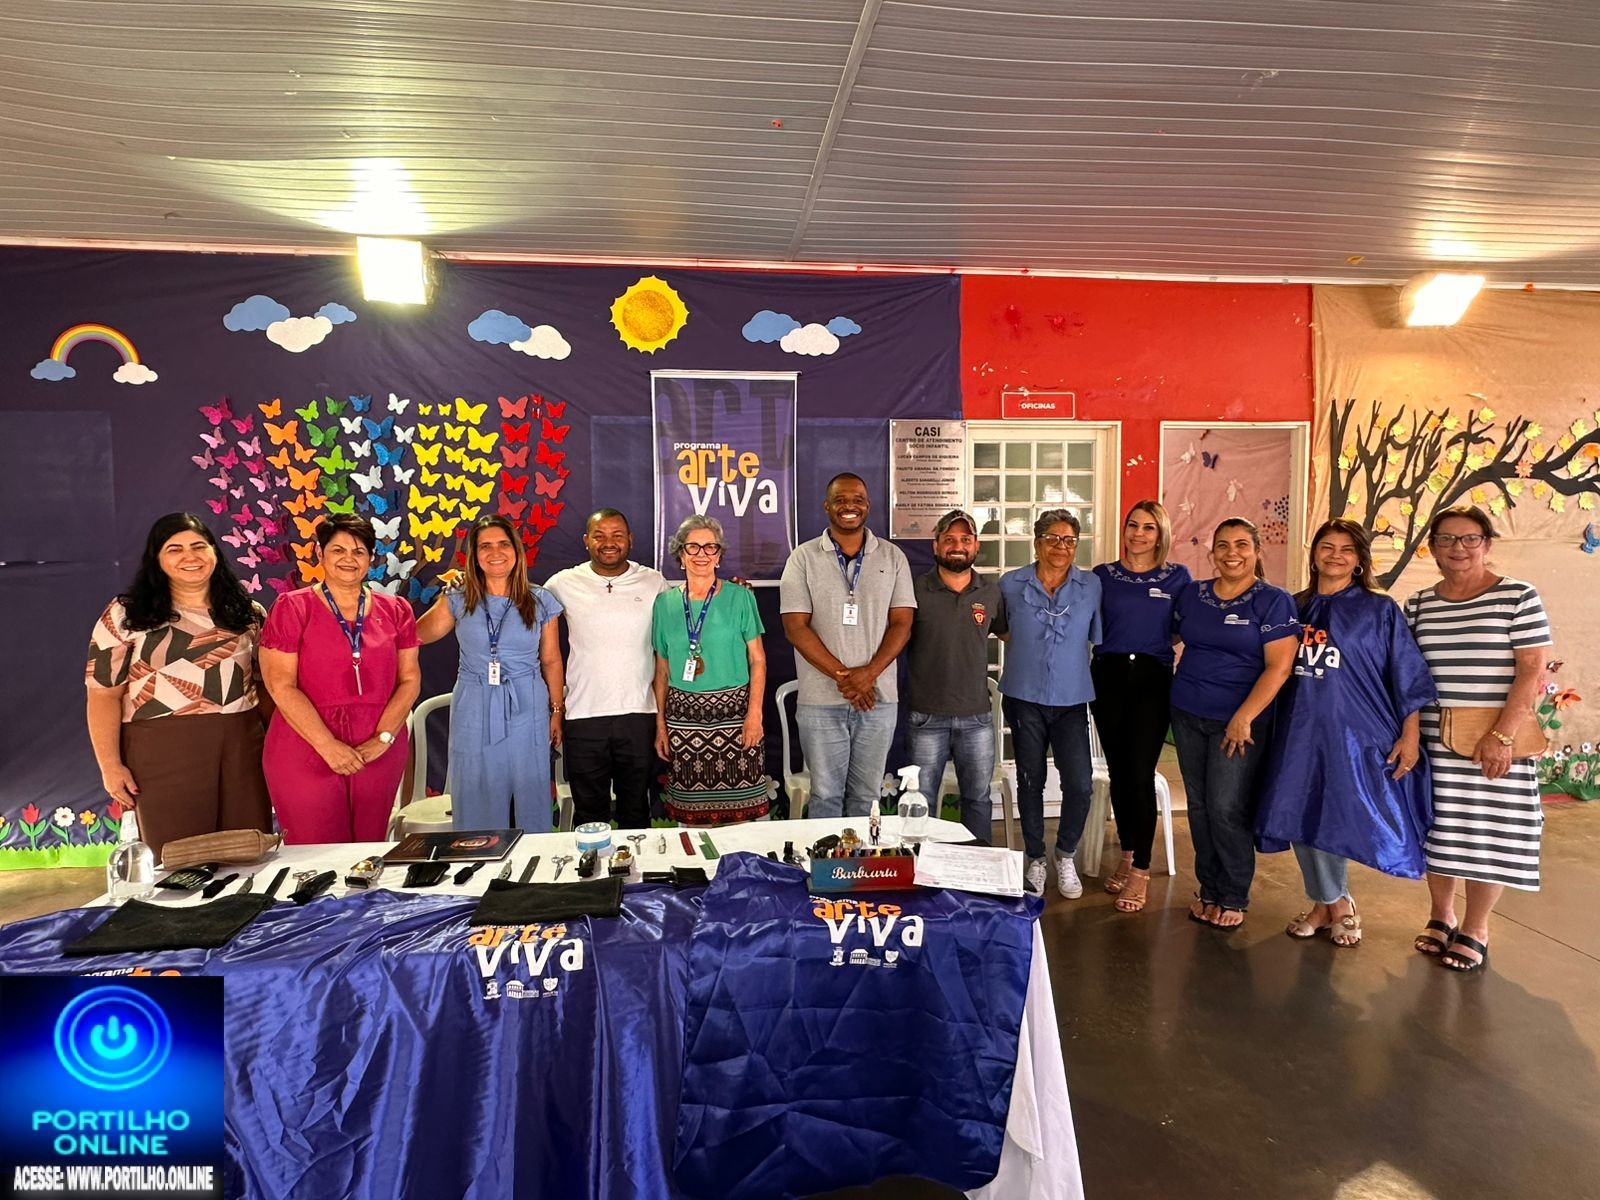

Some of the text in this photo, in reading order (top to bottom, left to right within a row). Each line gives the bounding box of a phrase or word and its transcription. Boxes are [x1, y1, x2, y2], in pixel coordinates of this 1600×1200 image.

[1020, 402, 1056, 410] OFICINAS
[914, 427, 941, 437] CASI
[673, 442, 721, 450] programa
[676, 443, 760, 488] arte
[1302, 624, 1328, 646] te
[1298, 643, 1341, 668] iva
[811, 900, 902, 921] arte
[467, 922, 568, 948] arte
